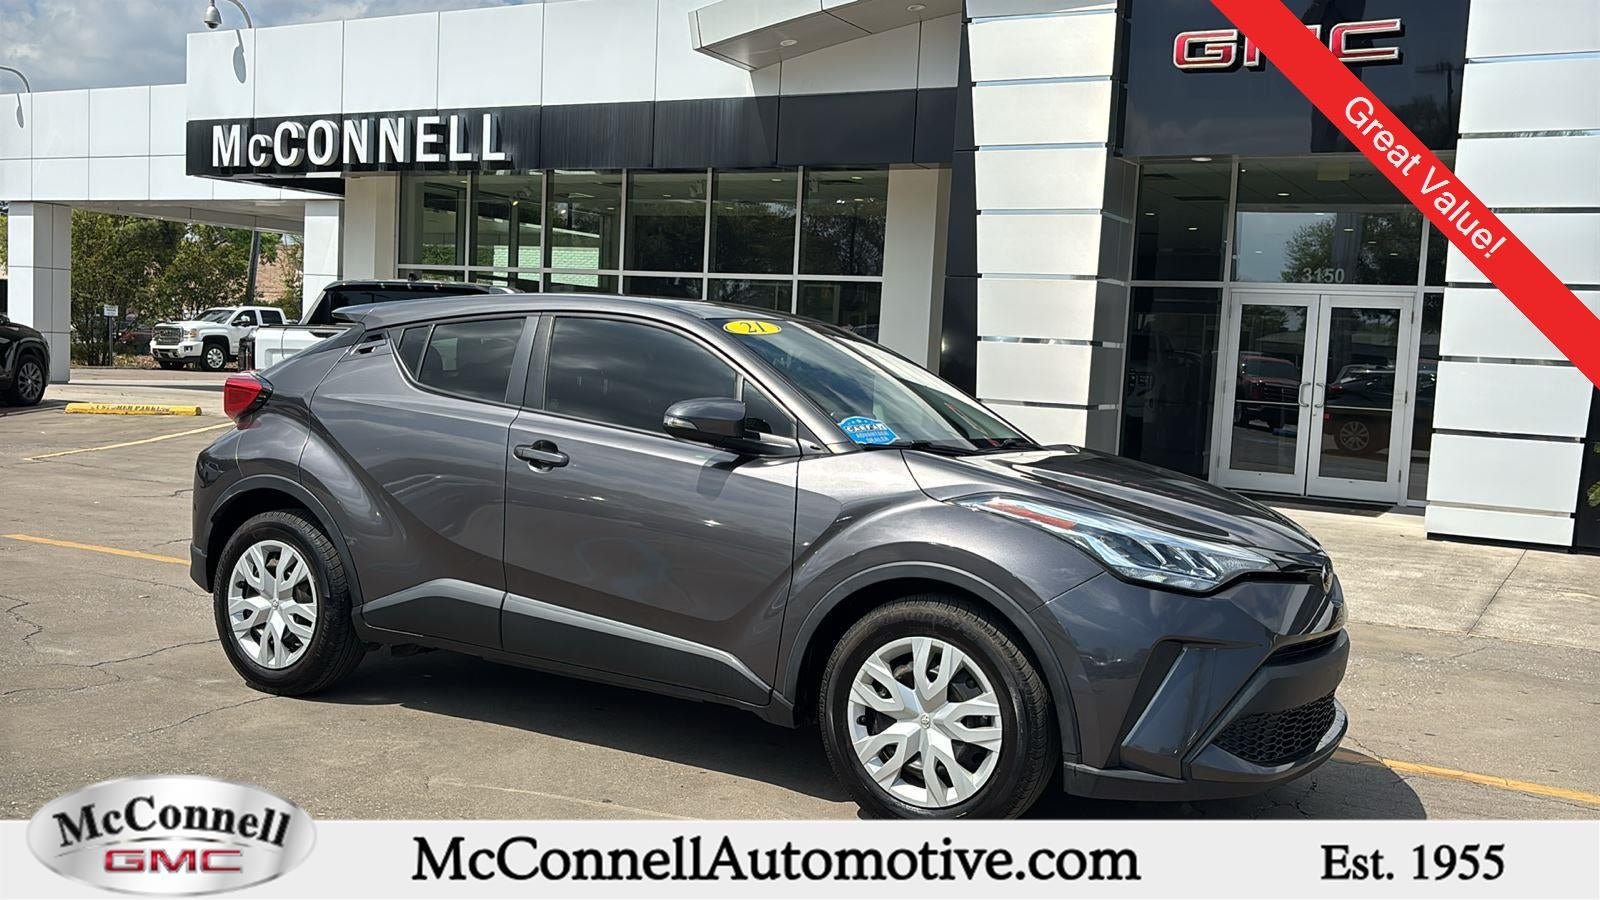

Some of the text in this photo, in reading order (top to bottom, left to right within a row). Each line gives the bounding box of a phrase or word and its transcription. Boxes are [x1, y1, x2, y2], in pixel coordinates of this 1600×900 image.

[1173, 18, 1402, 69] GC
[1302, 267, 1345, 283] 3150
[740, 321, 767, 333] 21
